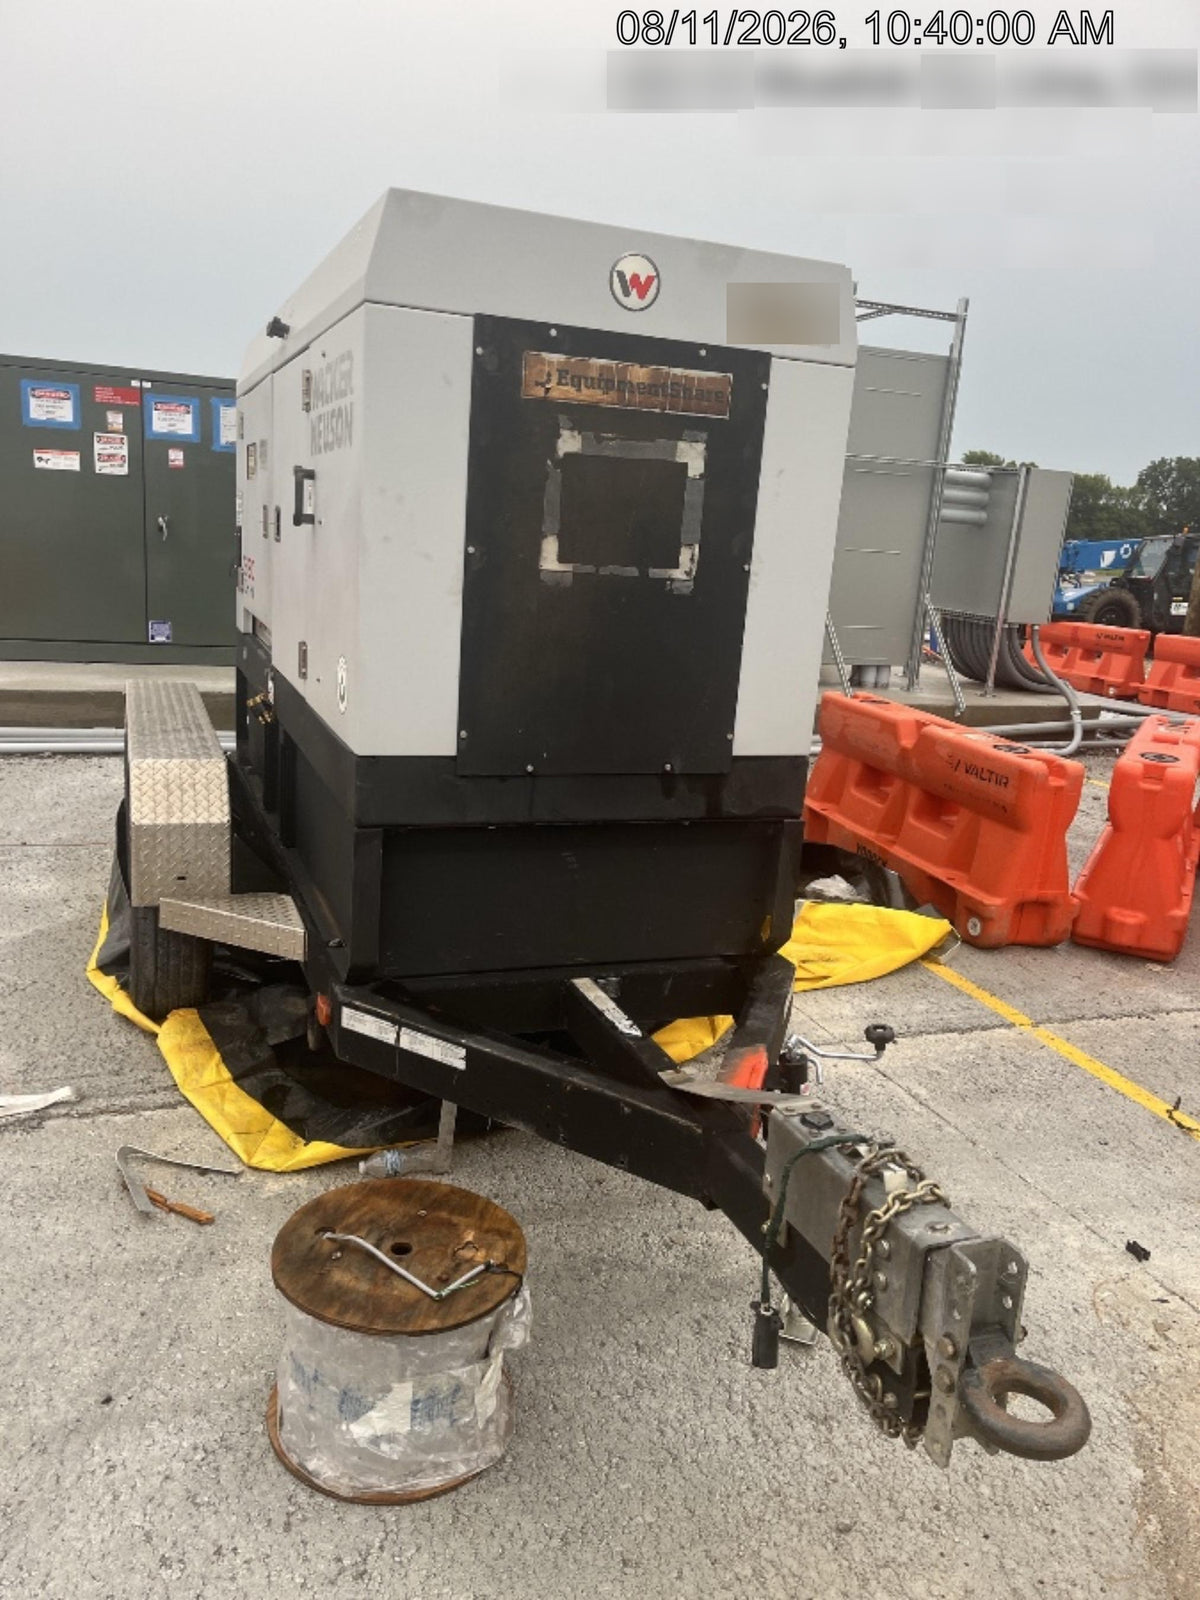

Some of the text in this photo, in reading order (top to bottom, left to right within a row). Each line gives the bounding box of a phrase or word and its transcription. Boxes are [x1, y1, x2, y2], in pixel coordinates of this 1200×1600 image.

[556, 368, 725, 403] EquipmentShare
[310, 401, 353, 457] NEUSON
[964, 761, 1010, 789] VALTIR
